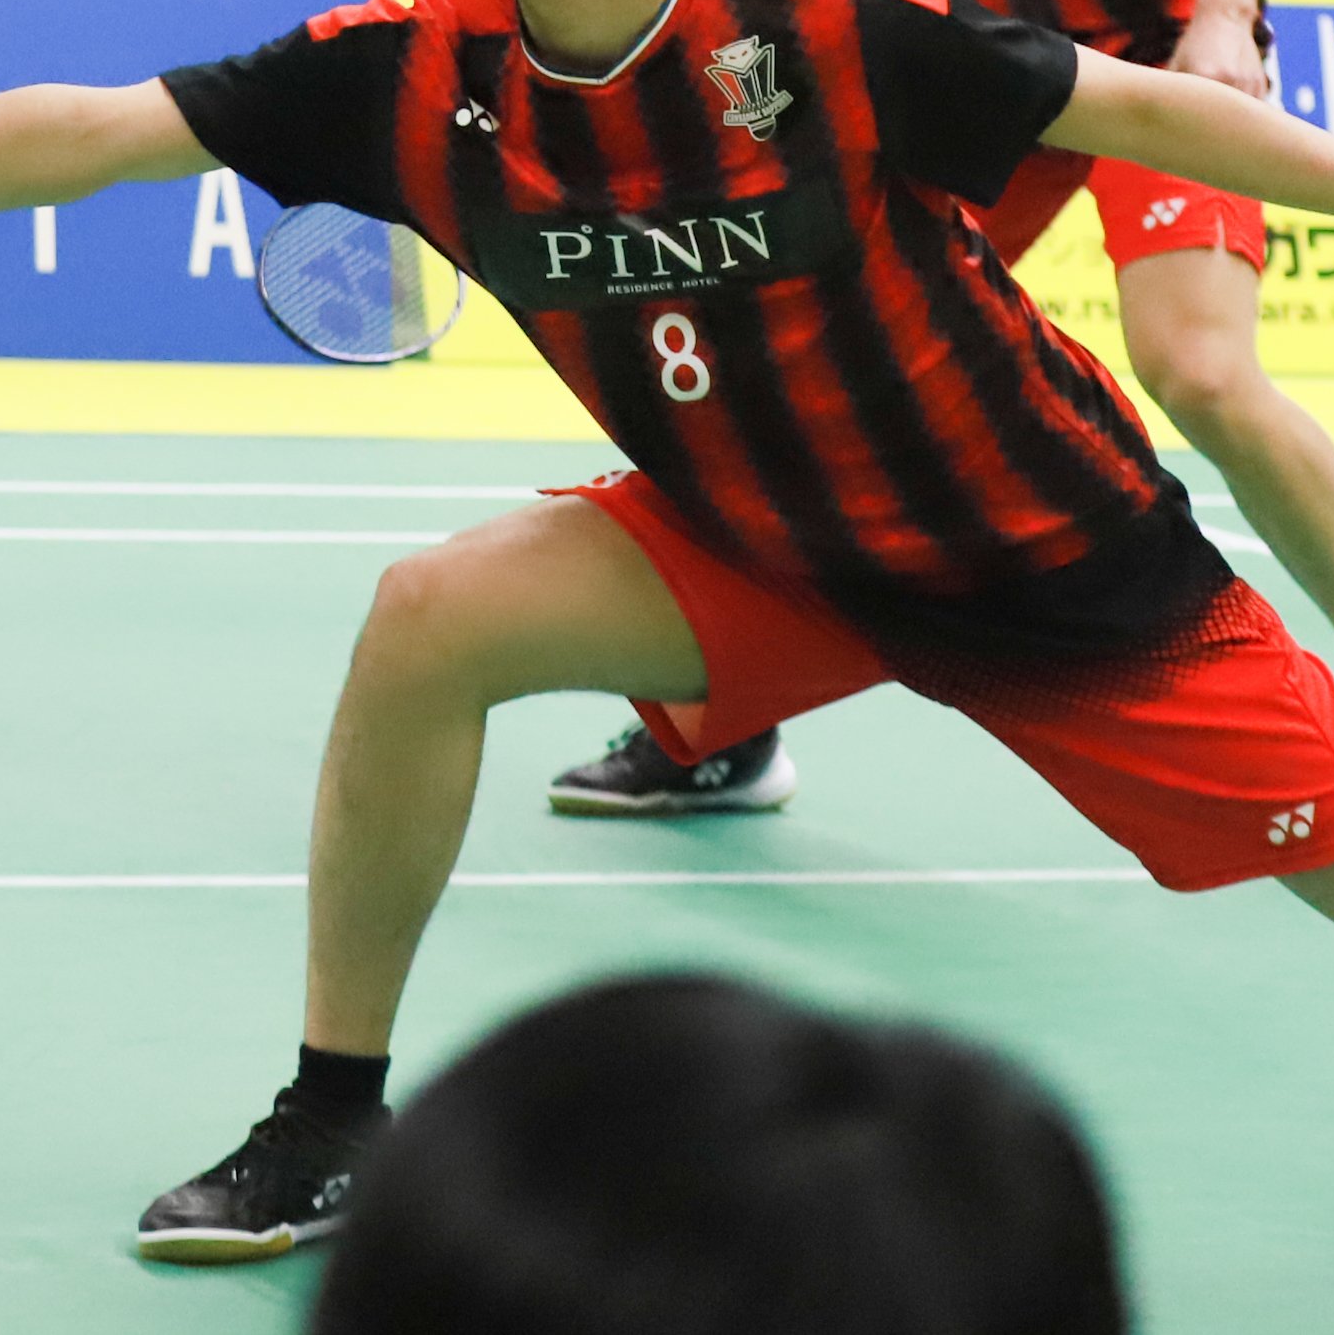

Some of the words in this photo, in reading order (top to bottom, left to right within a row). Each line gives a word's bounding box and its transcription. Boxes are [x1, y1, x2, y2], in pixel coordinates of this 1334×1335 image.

[607, 280, 674, 295] RESIDENCE
[681, 277, 721, 288] HOTEL
[651, 312, 711, 403] 8
